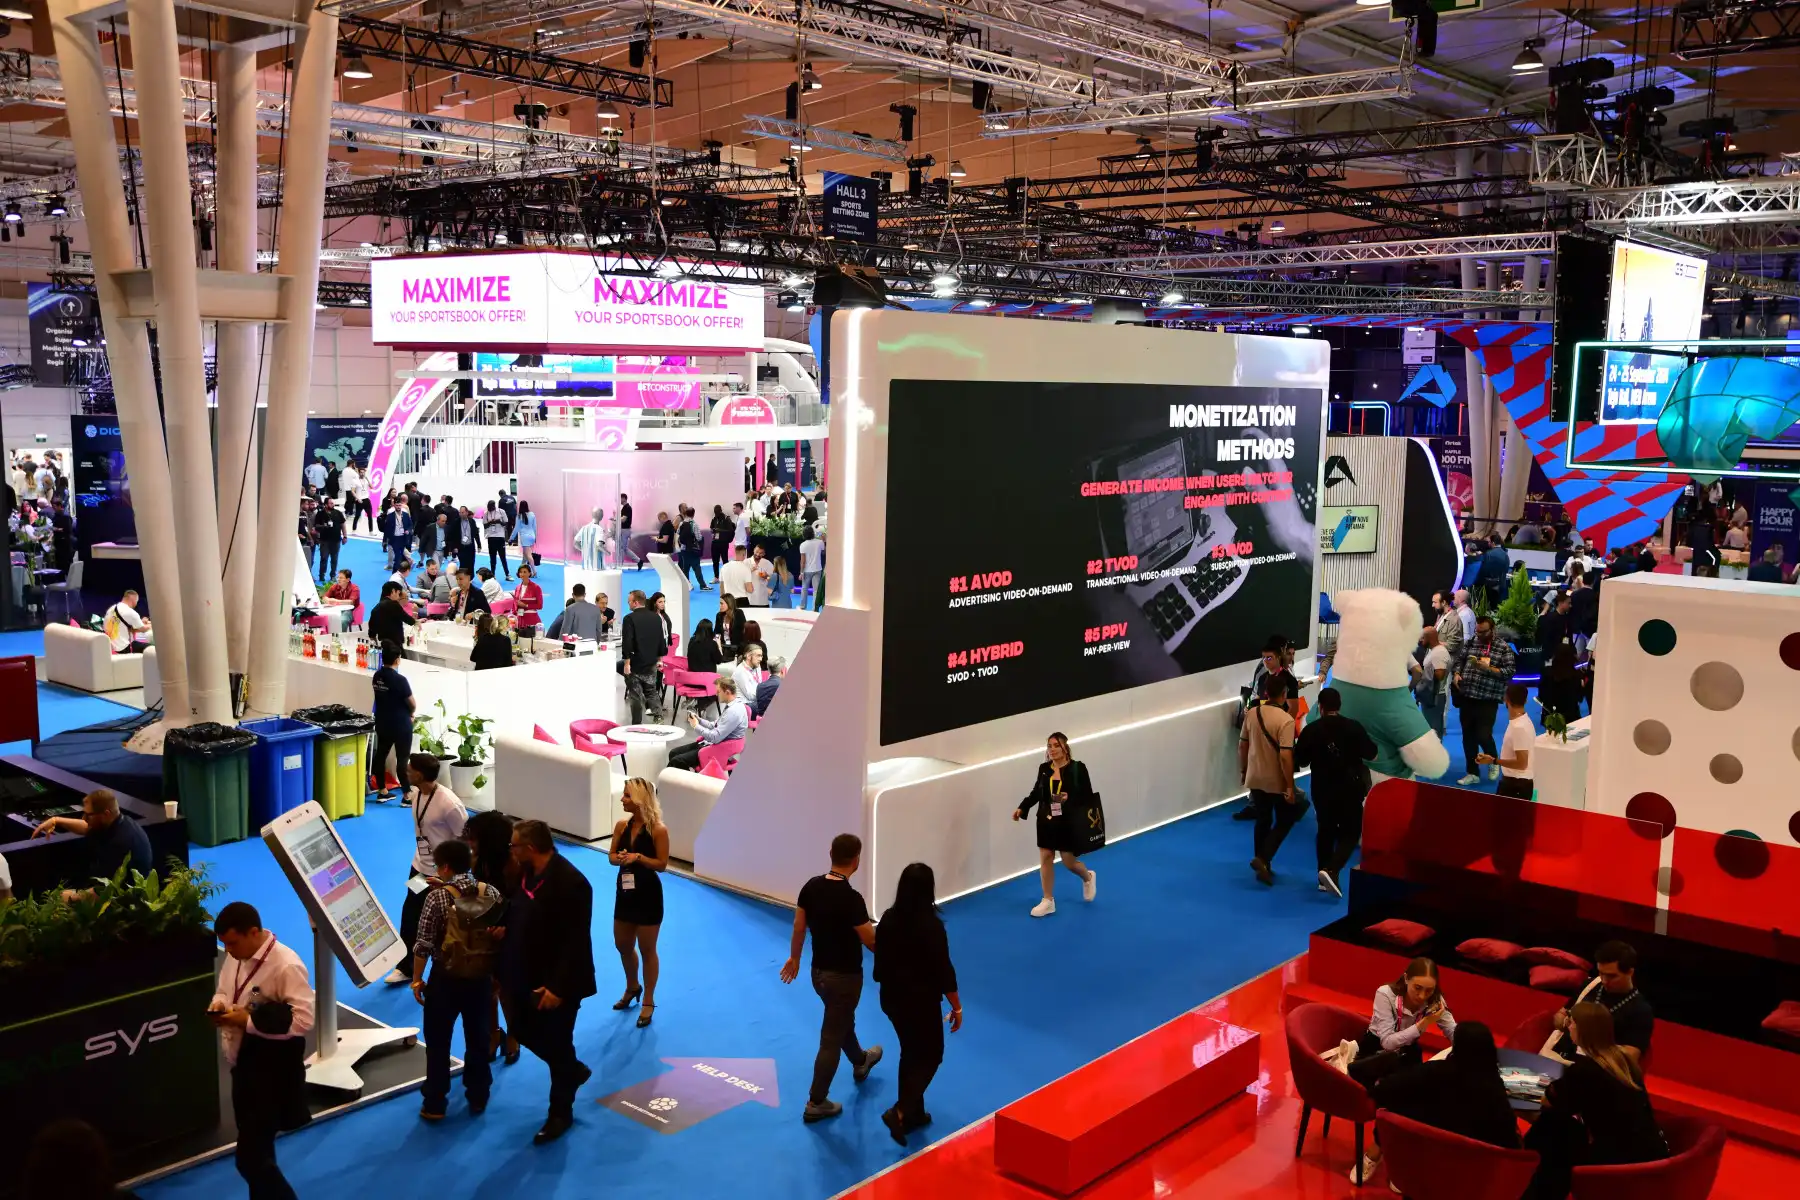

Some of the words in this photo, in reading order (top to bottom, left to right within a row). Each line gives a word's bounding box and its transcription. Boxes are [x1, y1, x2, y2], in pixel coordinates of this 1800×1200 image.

[837, 185, 859, 198] HALL
[861, 189, 866, 199] 3
[832, 206, 855, 216] BETTING
[855, 210, 870, 219] ZONE
[841, 201, 861, 210] SPORTS
[403, 276, 511, 303] MAXIMIZE
[594, 277, 728, 309] MAXIMIZE
[390, 311, 416, 323] YOUR
[419, 310, 486, 323] SPORTSBOOK
[489, 310, 526, 322] OFFER!
[575, 311, 612, 325] YOUR
[616, 312, 700, 327] SPORTSBOOK
[703, 316, 744, 329] OFFER!
[1170, 404, 1296, 427] MONETIZATION
[1217, 438, 1295, 461] METHODS
[1081, 480, 1142, 497] GENERATE
[1144, 476, 1184, 493] INCOME
[1186, 475, 1215, 490] WHEN
[1216, 474, 1246, 488] USERS
[1184, 494, 1224, 509] ENGAGE
[1225, 491, 1250, 506] WITH
[1760, 507, 1795, 517] HAPPY
[1760, 515, 1793, 526] HOUR
[1087, 560, 1104, 575] #2
[1104, 555, 1138, 573] TVOD
[1211, 559, 1250, 571] SUBSCRIPTION
[1250, 552, 1296, 565] VIDEO-ON-DEMAND
[949, 576, 968, 593] #1
[971, 571, 1012, 591] AVOD
[1086, 573, 1139, 589] TRANSACTIONAL
[1140, 566, 1197, 581] VIDEO-ON-DEMAND
[949, 593, 1001, 608] ADVERTISING
[1003, 583, 1073, 601] VIDEO-ON-DEMAND
[1084, 627, 1100, 643] #5
[1102, 622, 1128, 640] PPV
[947, 652, 967, 668] #4
[969, 640, 1024, 665] HYBRID
[1084, 640, 1131, 657] PAY-PER-VIEW
[947, 670, 969, 684] SVOD
[977, 665, 998, 680] TVOD
[692, 1062, 729, 1079] HELP
[724, 1076, 764, 1094] DESK
